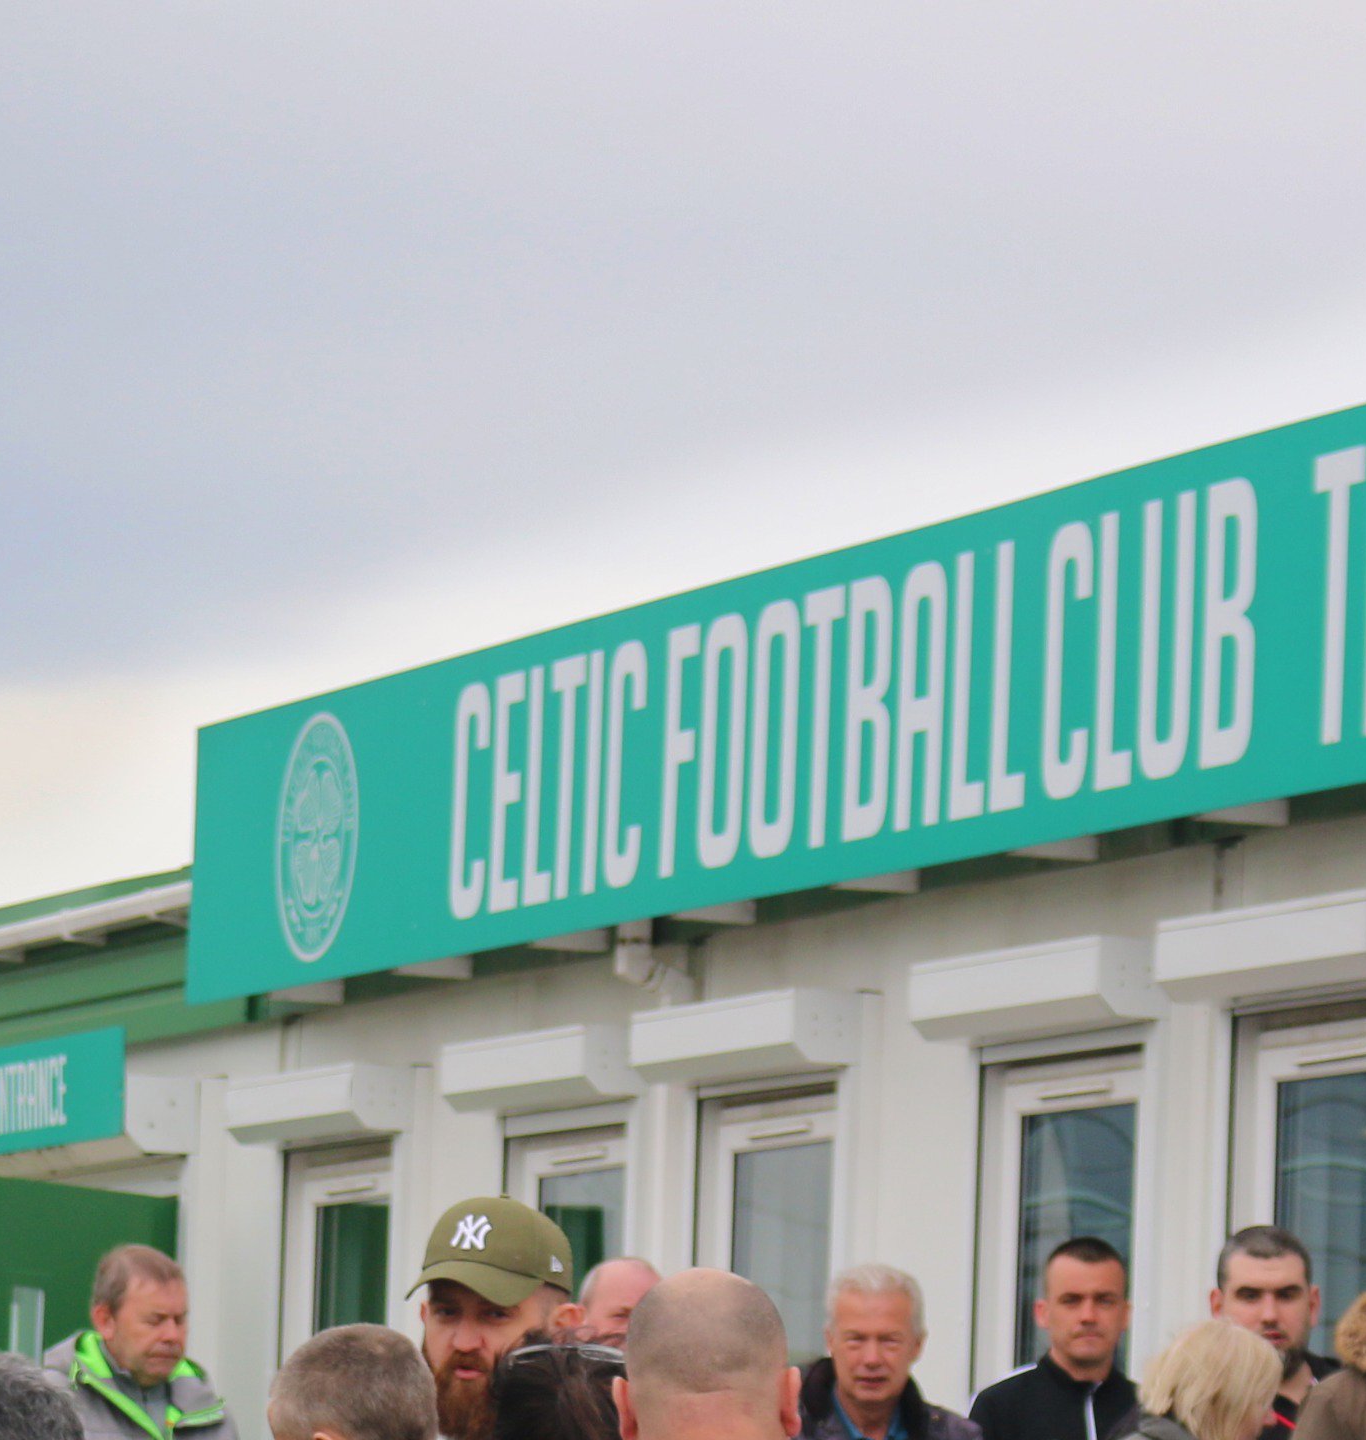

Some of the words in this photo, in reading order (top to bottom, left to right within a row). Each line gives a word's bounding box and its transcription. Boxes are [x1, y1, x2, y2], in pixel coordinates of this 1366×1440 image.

[448, 639, 649, 921] CELTIC
[658, 539, 1027, 880] FOOTBALL
[1040, 476, 1259, 801] CLUB
[449, 1213, 493, 1251] NY
